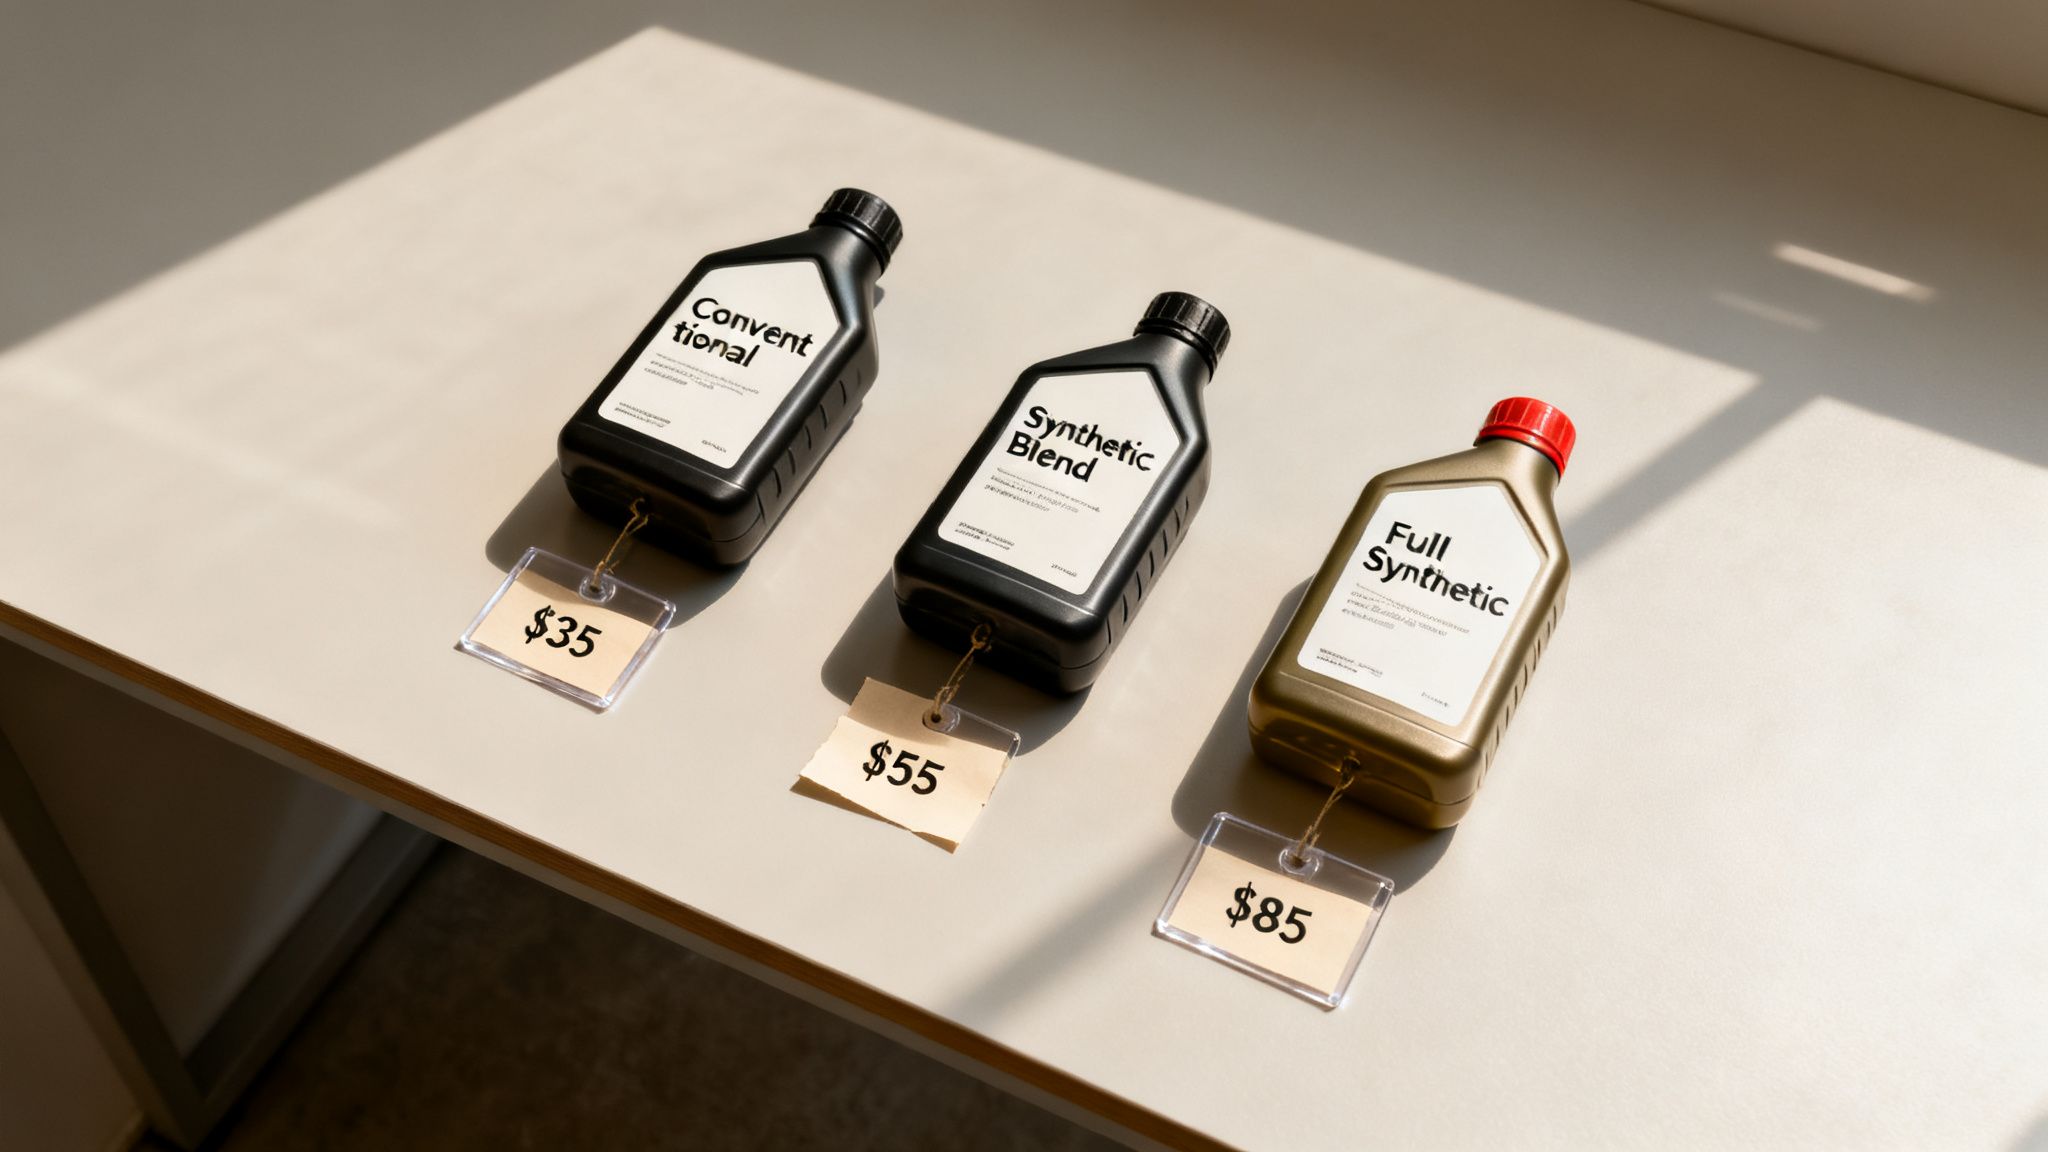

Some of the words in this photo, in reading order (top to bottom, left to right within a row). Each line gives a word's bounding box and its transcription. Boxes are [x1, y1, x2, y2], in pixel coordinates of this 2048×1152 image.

[672, 321, 760, 367] tional
[692, 297, 814, 357] Convent
[1006, 431, 1098, 482] Blend
[1023, 405, 1155, 471] Synthetic
[1385, 521, 1452, 561] Full
[1362, 546, 1510, 616] Synthetic
[524, 605, 602, 657] $35
[862, 740, 945, 795] $55
[1225, 881, 1313, 944] $85
